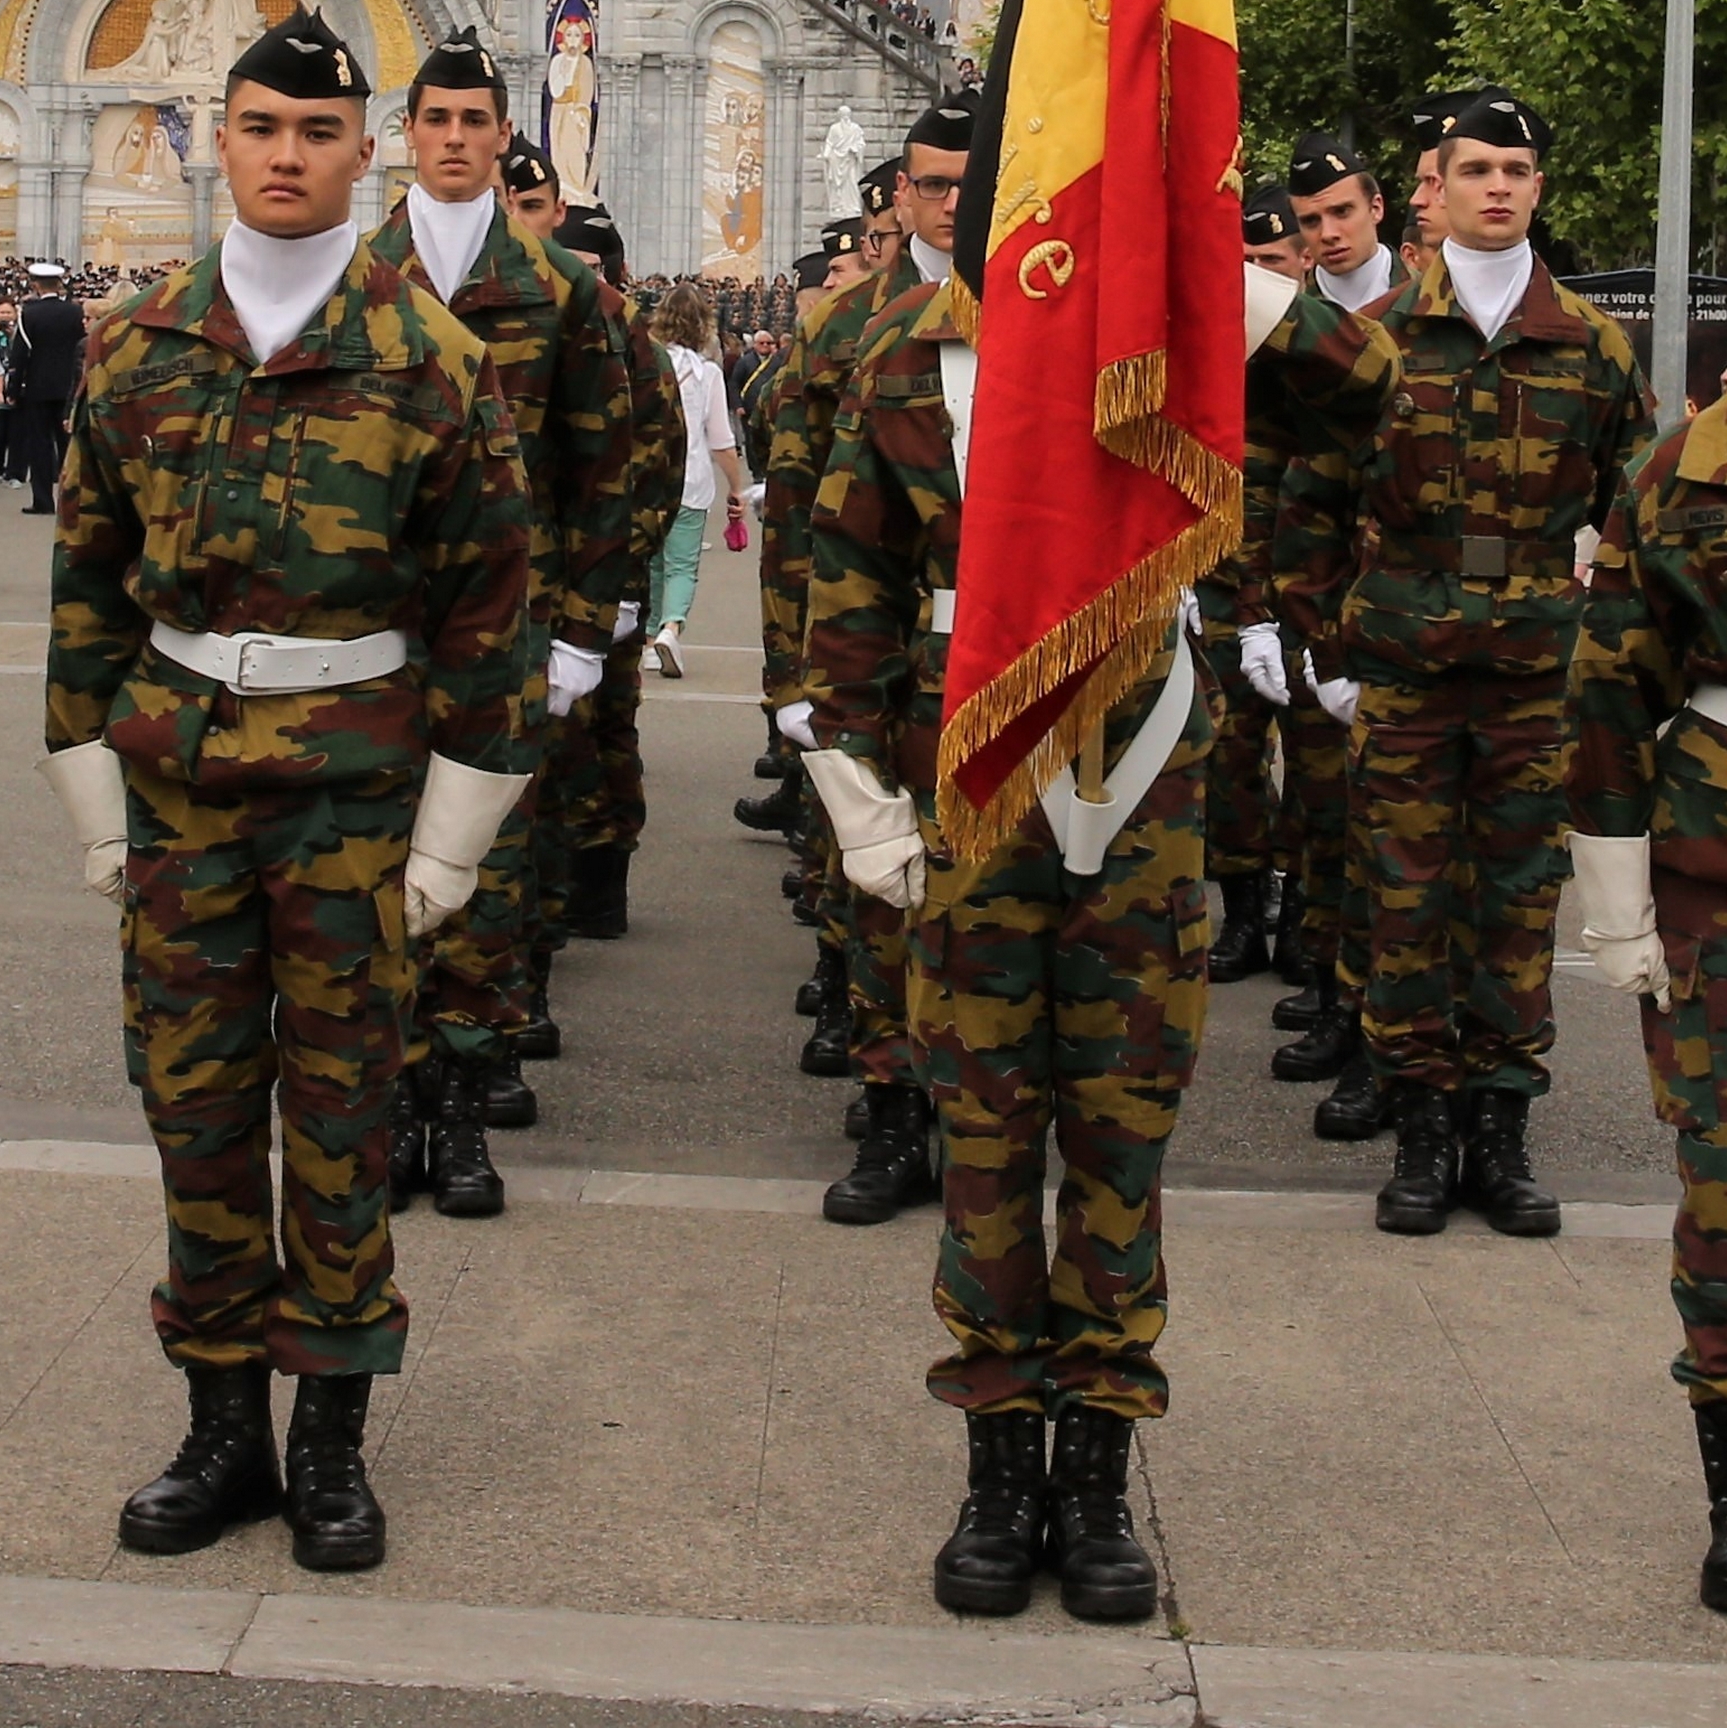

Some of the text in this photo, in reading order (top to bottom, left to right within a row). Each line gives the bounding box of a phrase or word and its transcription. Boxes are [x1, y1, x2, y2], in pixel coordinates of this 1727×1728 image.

[1611, 292, 1646, 304] votre
[1696, 294, 1727, 308] pour
[1636, 309, 1650, 320] de
[1696, 309, 1727, 321] 21h00
